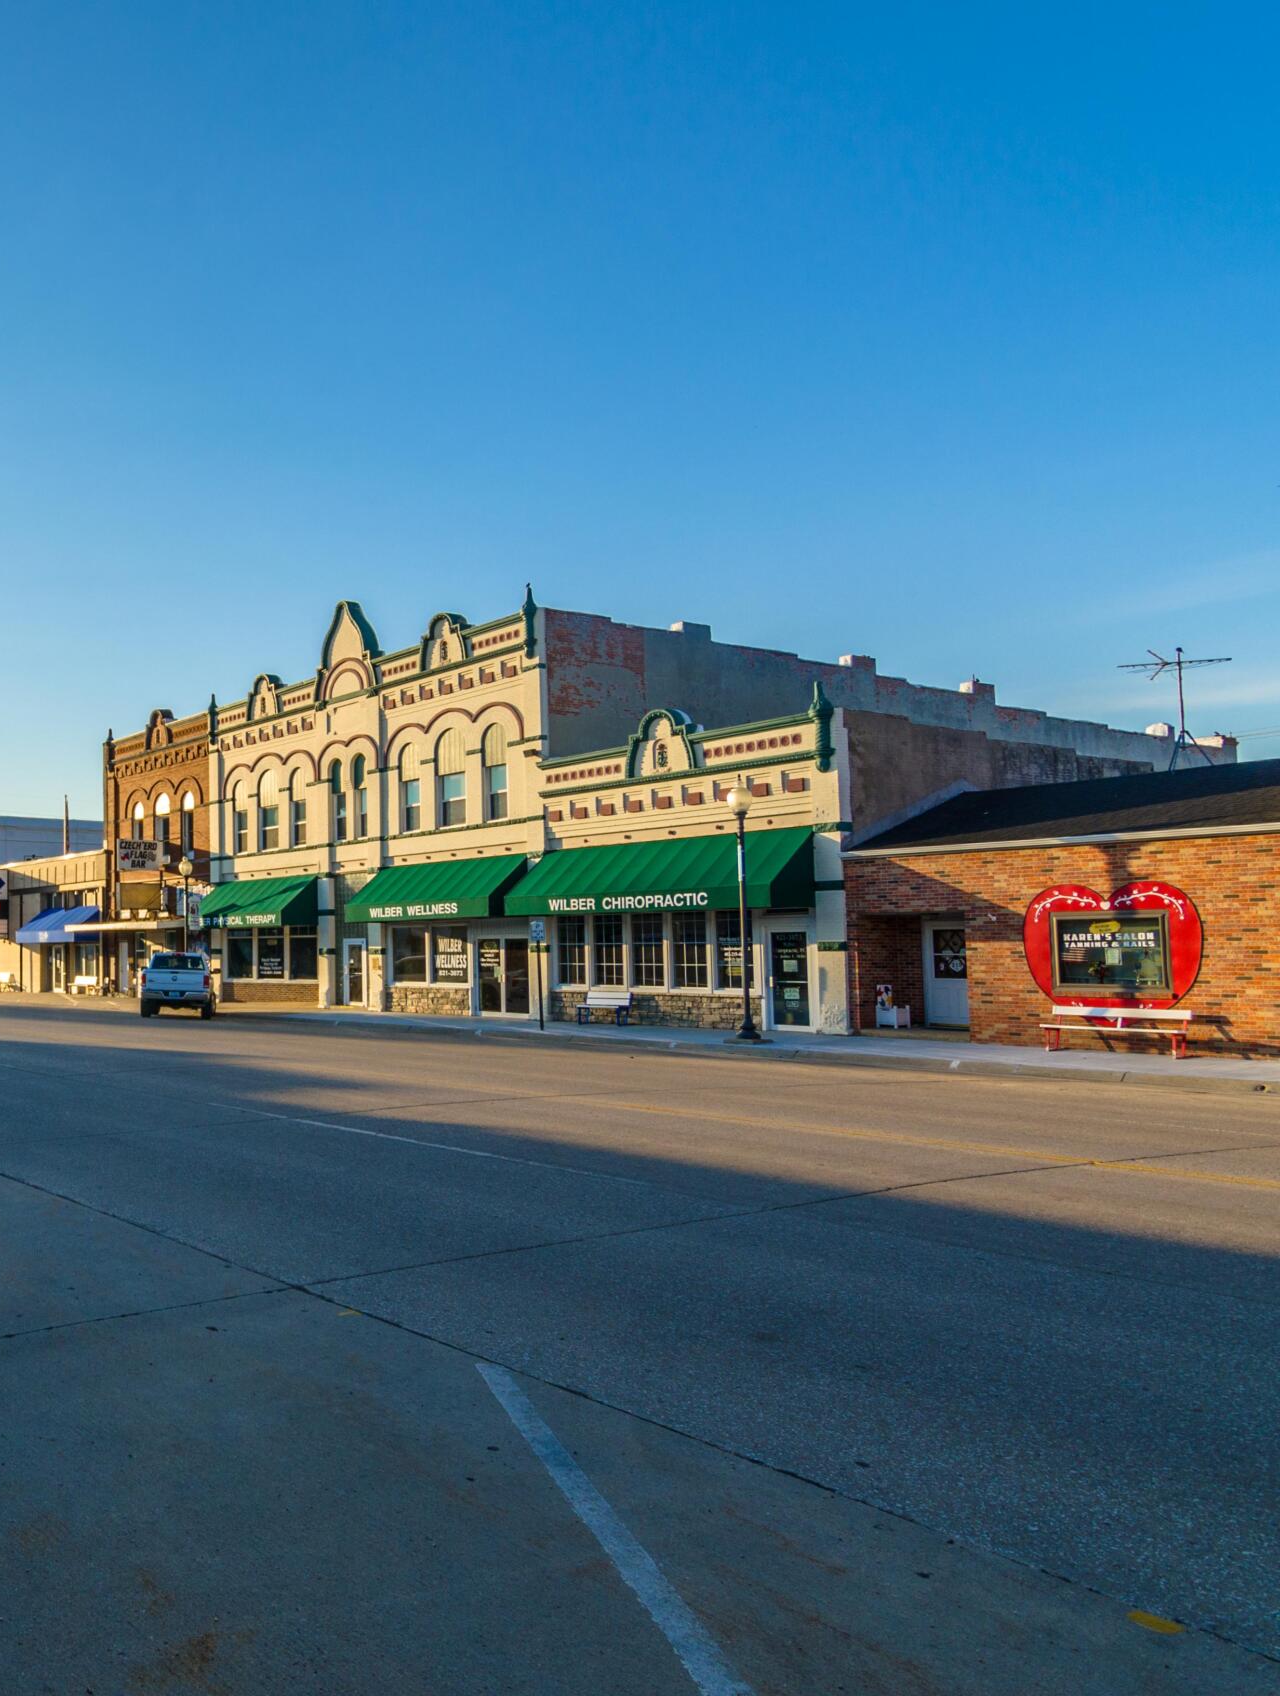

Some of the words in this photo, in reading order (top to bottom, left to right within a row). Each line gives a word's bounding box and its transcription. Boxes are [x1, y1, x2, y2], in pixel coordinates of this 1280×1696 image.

[120, 841, 141, 849] CZECH
[130, 850, 148, 859] FLAG
[131, 860, 146, 868] BAR
[548, 898, 596, 911] WILBER
[602, 892, 708, 910] CHIROPRACTIC
[369, 906, 403, 919] WILBER
[406, 902, 458, 916] WELLNESS
[213, 915, 243, 926] PHYSICAL
[245, 913, 276, 925] THERAPY
[1063, 933, 1112, 941] KAREN'S
[1115, 932, 1155, 940] SALON
[438, 938, 462, 952] WILBER
[1123, 940, 1155, 948] NAILS
[435, 954, 467, 969] WELLNESS
